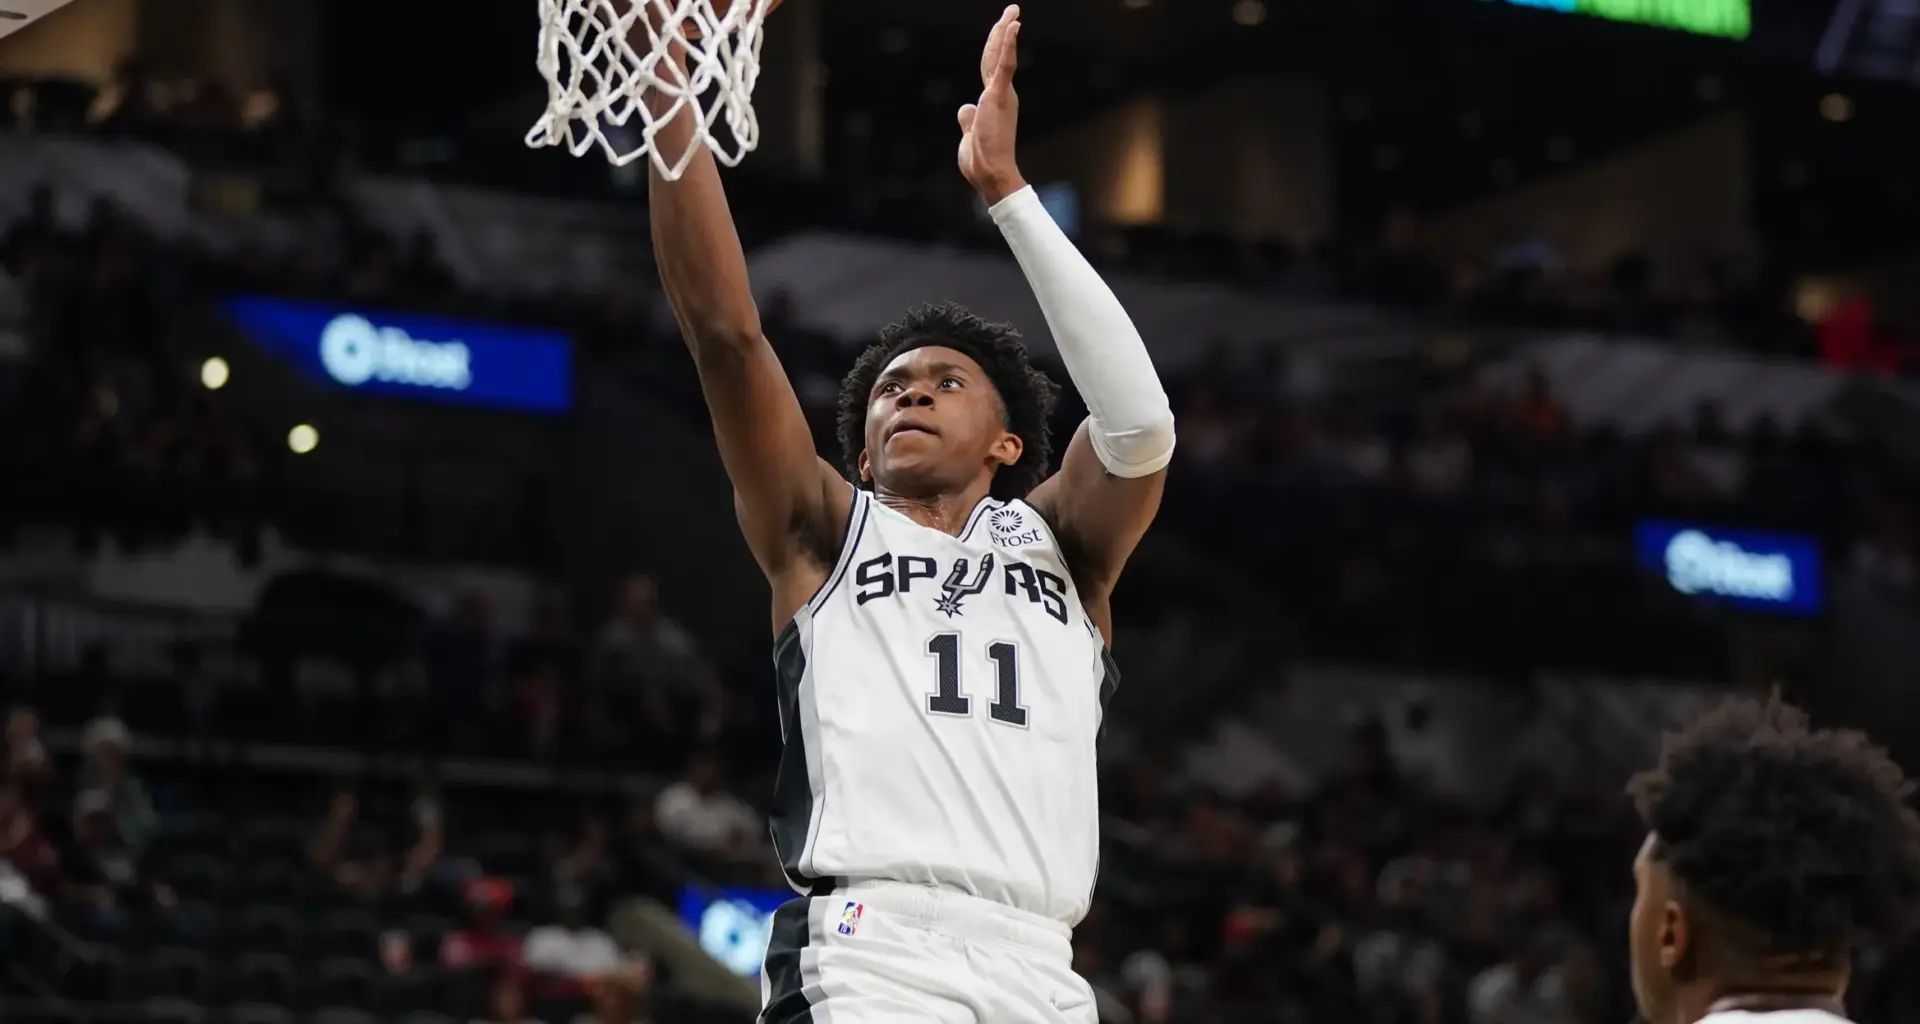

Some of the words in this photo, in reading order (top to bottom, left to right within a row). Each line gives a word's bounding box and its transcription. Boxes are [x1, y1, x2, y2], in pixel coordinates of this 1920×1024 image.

[990, 528, 1043, 547] Frost
[856, 552, 1068, 625] SPURS
[925, 631, 1029, 729] 11
